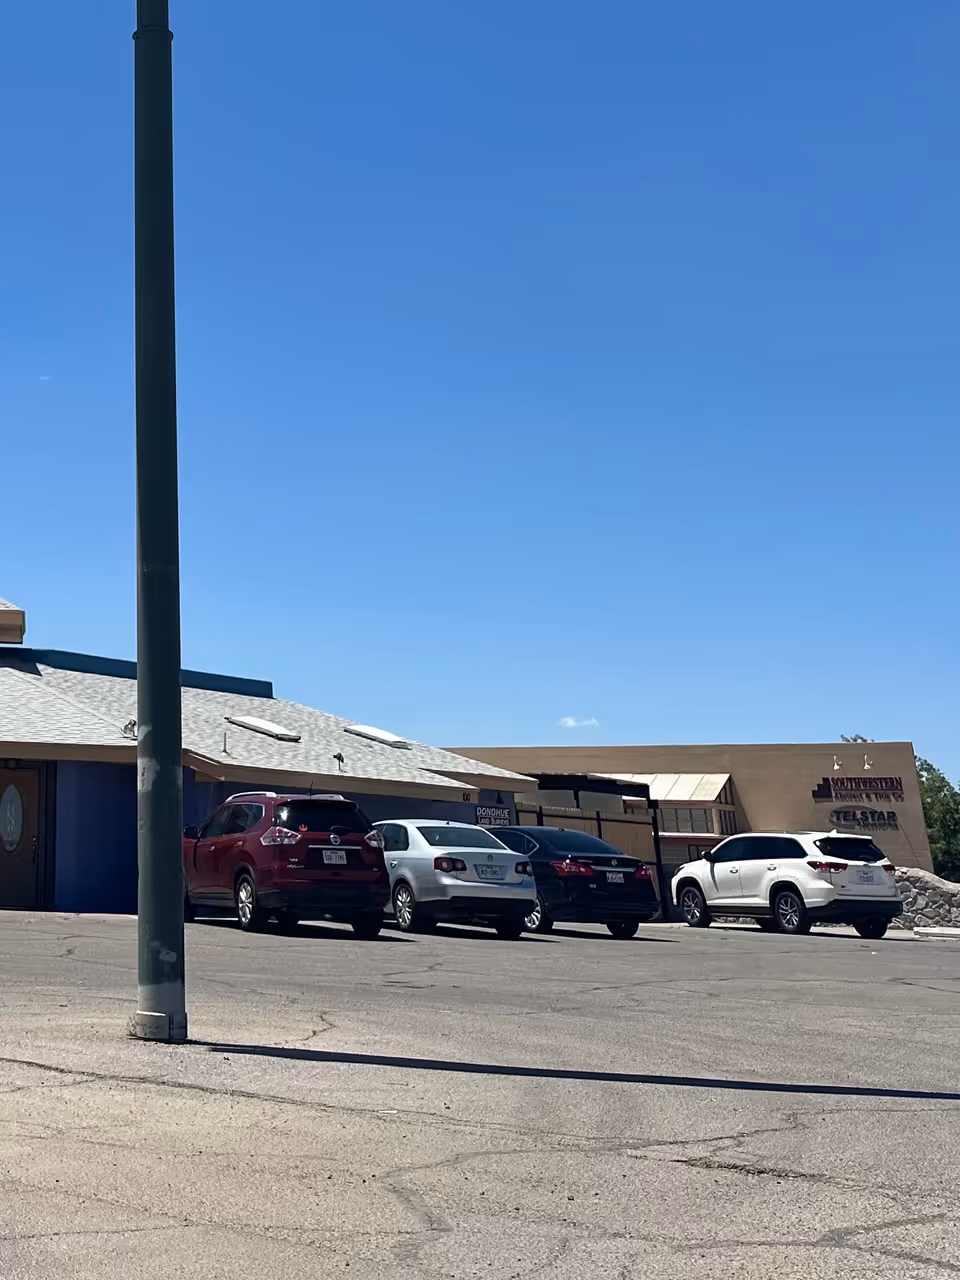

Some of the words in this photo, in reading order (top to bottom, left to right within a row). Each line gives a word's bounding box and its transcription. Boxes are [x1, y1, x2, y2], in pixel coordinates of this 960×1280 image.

[831, 777, 902, 790] SOUTHWESTERN
[477, 807, 509, 818] DONOHUE
[834, 810, 897, 822] TELSTAR
